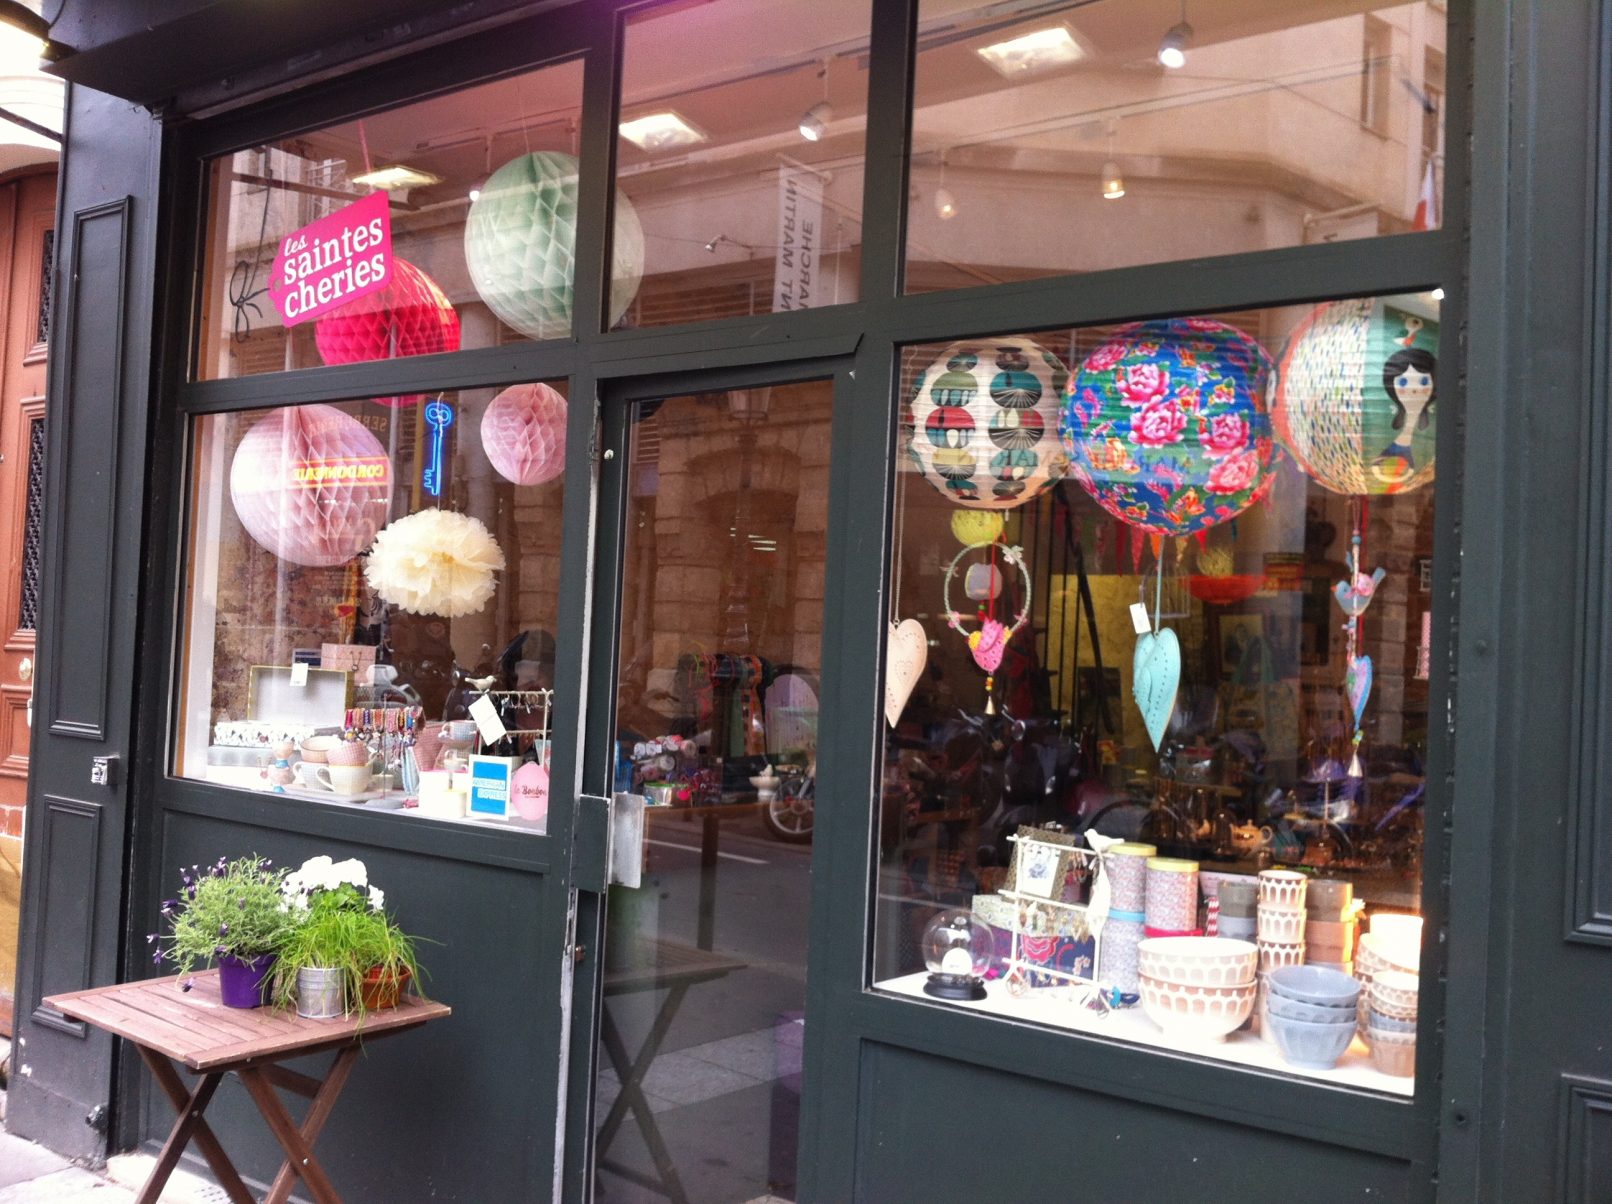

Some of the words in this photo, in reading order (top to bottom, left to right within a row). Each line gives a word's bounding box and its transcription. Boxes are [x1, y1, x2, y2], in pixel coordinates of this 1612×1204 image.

[284, 235, 308, 257] les
[284, 218, 384, 285] saintes
[284, 253, 386, 318] cheries
